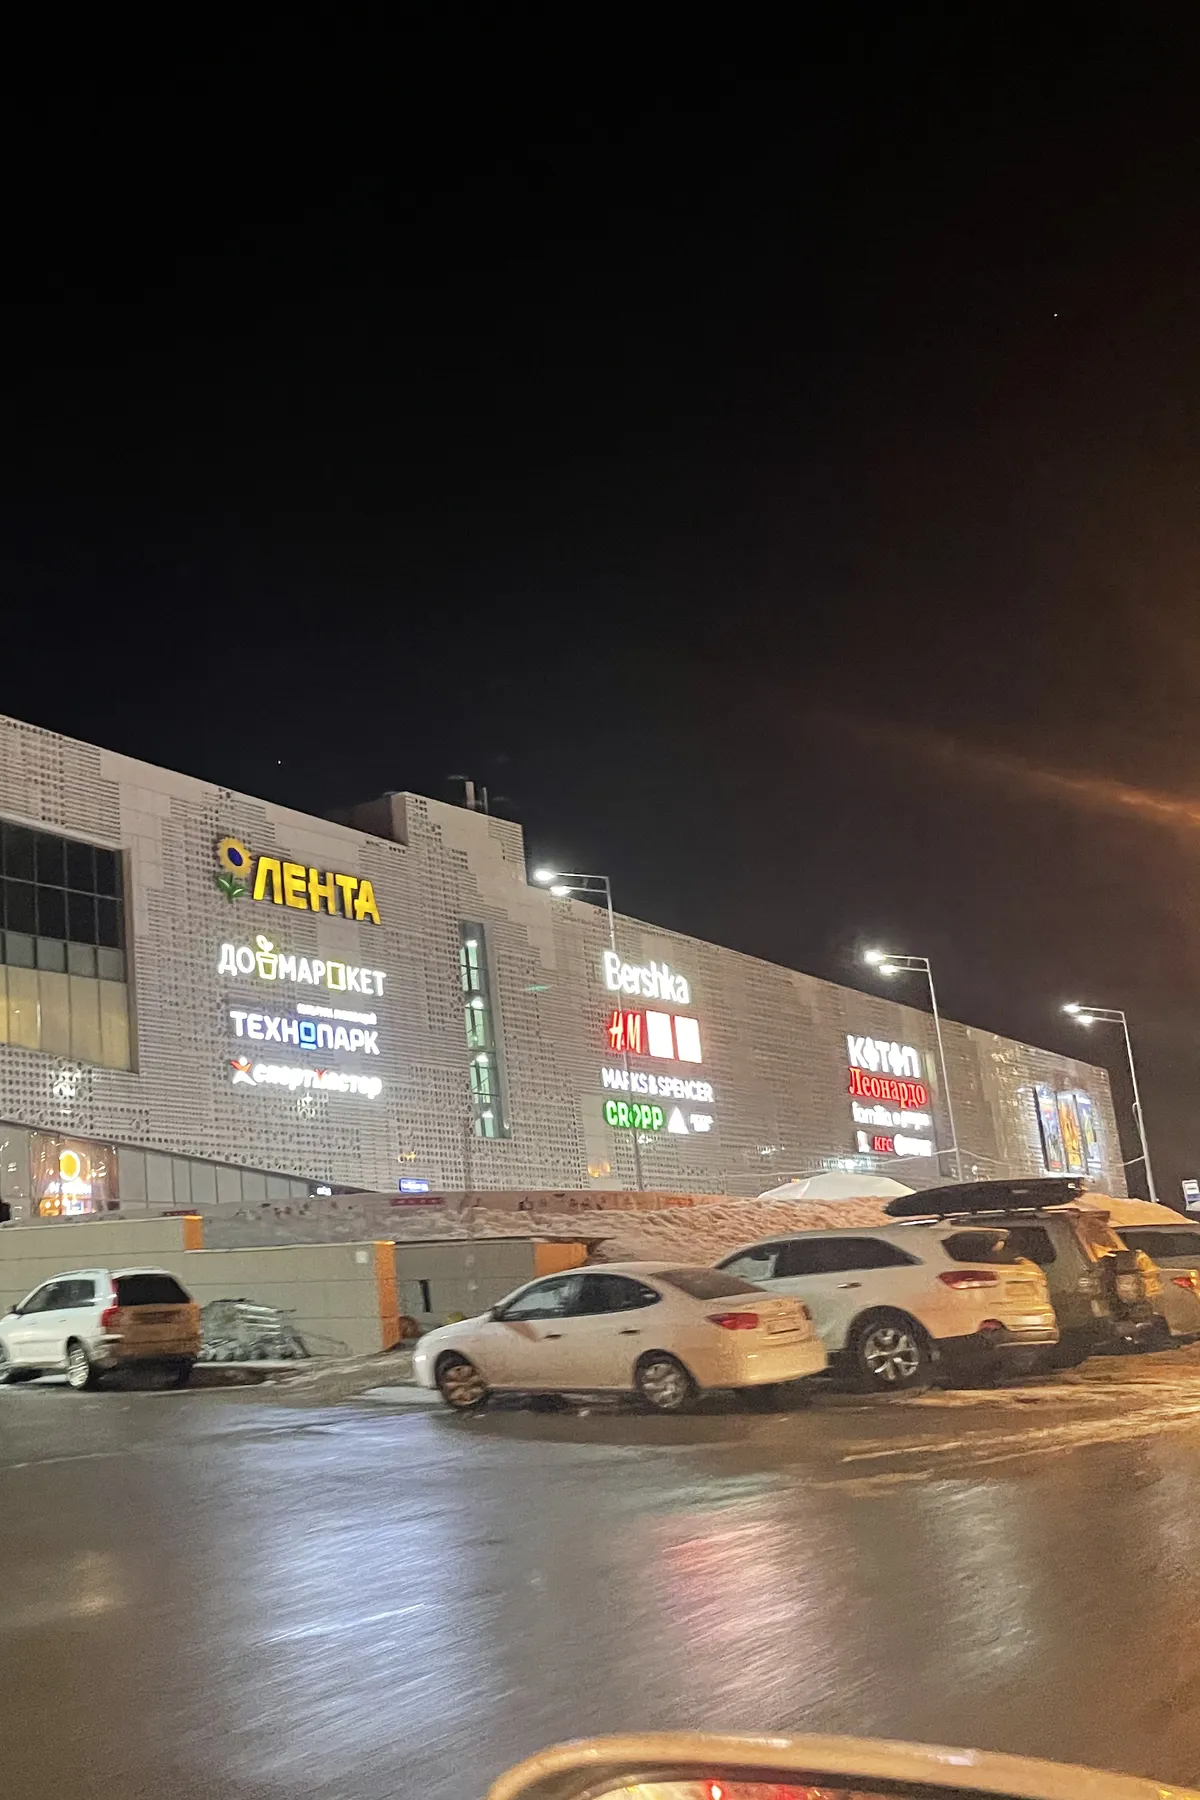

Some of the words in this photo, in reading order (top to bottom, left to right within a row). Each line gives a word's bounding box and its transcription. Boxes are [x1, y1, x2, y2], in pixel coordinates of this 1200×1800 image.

[253, 856, 381, 924] ЛЕНТА
[604, 951, 689, 1004] Bershka
[230, 1011, 380, 1055] ТЕХНОПАРК
[850, 1067, 926, 1108] Леонардо
[606, 1101, 663, 1130] CROPP
[874, 1136, 893, 1151] KFC
